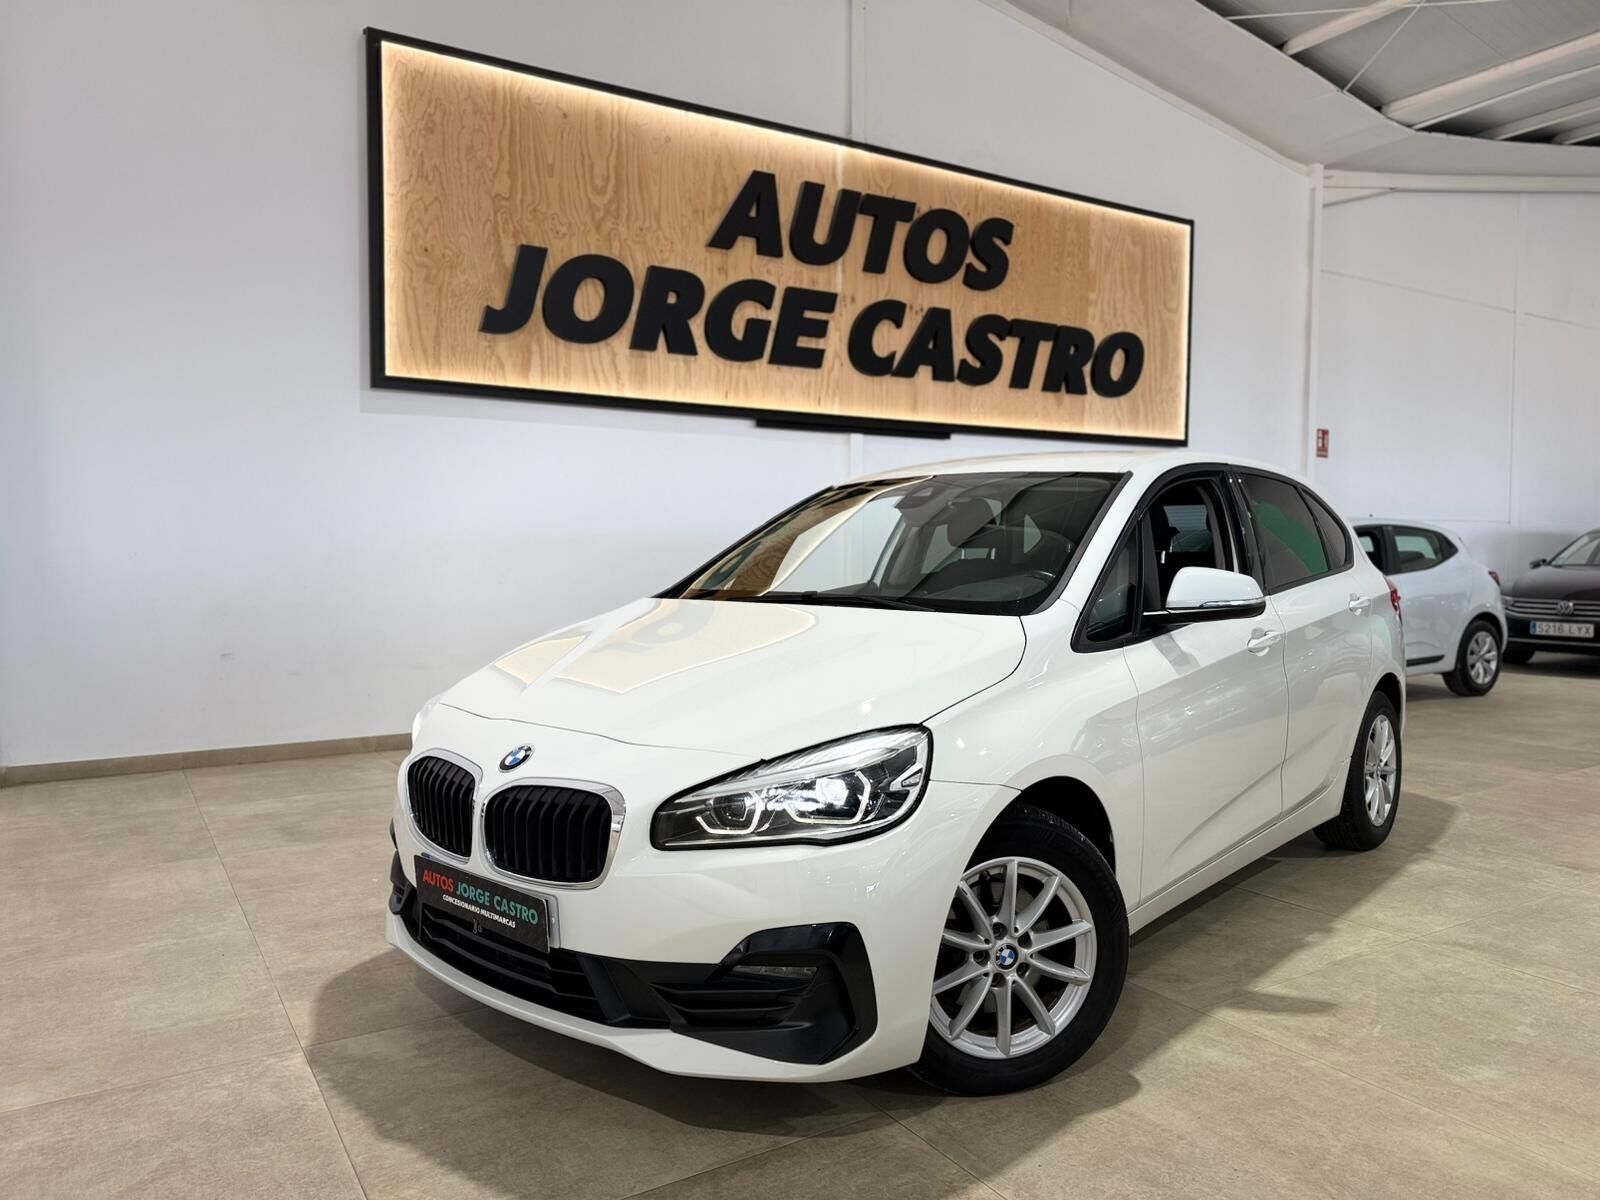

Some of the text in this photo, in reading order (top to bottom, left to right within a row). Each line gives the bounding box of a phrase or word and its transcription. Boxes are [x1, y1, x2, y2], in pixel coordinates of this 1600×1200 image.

[706, 170, 1014, 291] AUTOS
[479, 244, 1145, 398] JORGE CASTRO
[422, 869, 539, 925] AUTOS JORGE CASTRO
[442, 894, 516, 928] CONCESIONARIO MULTIMARCAS
